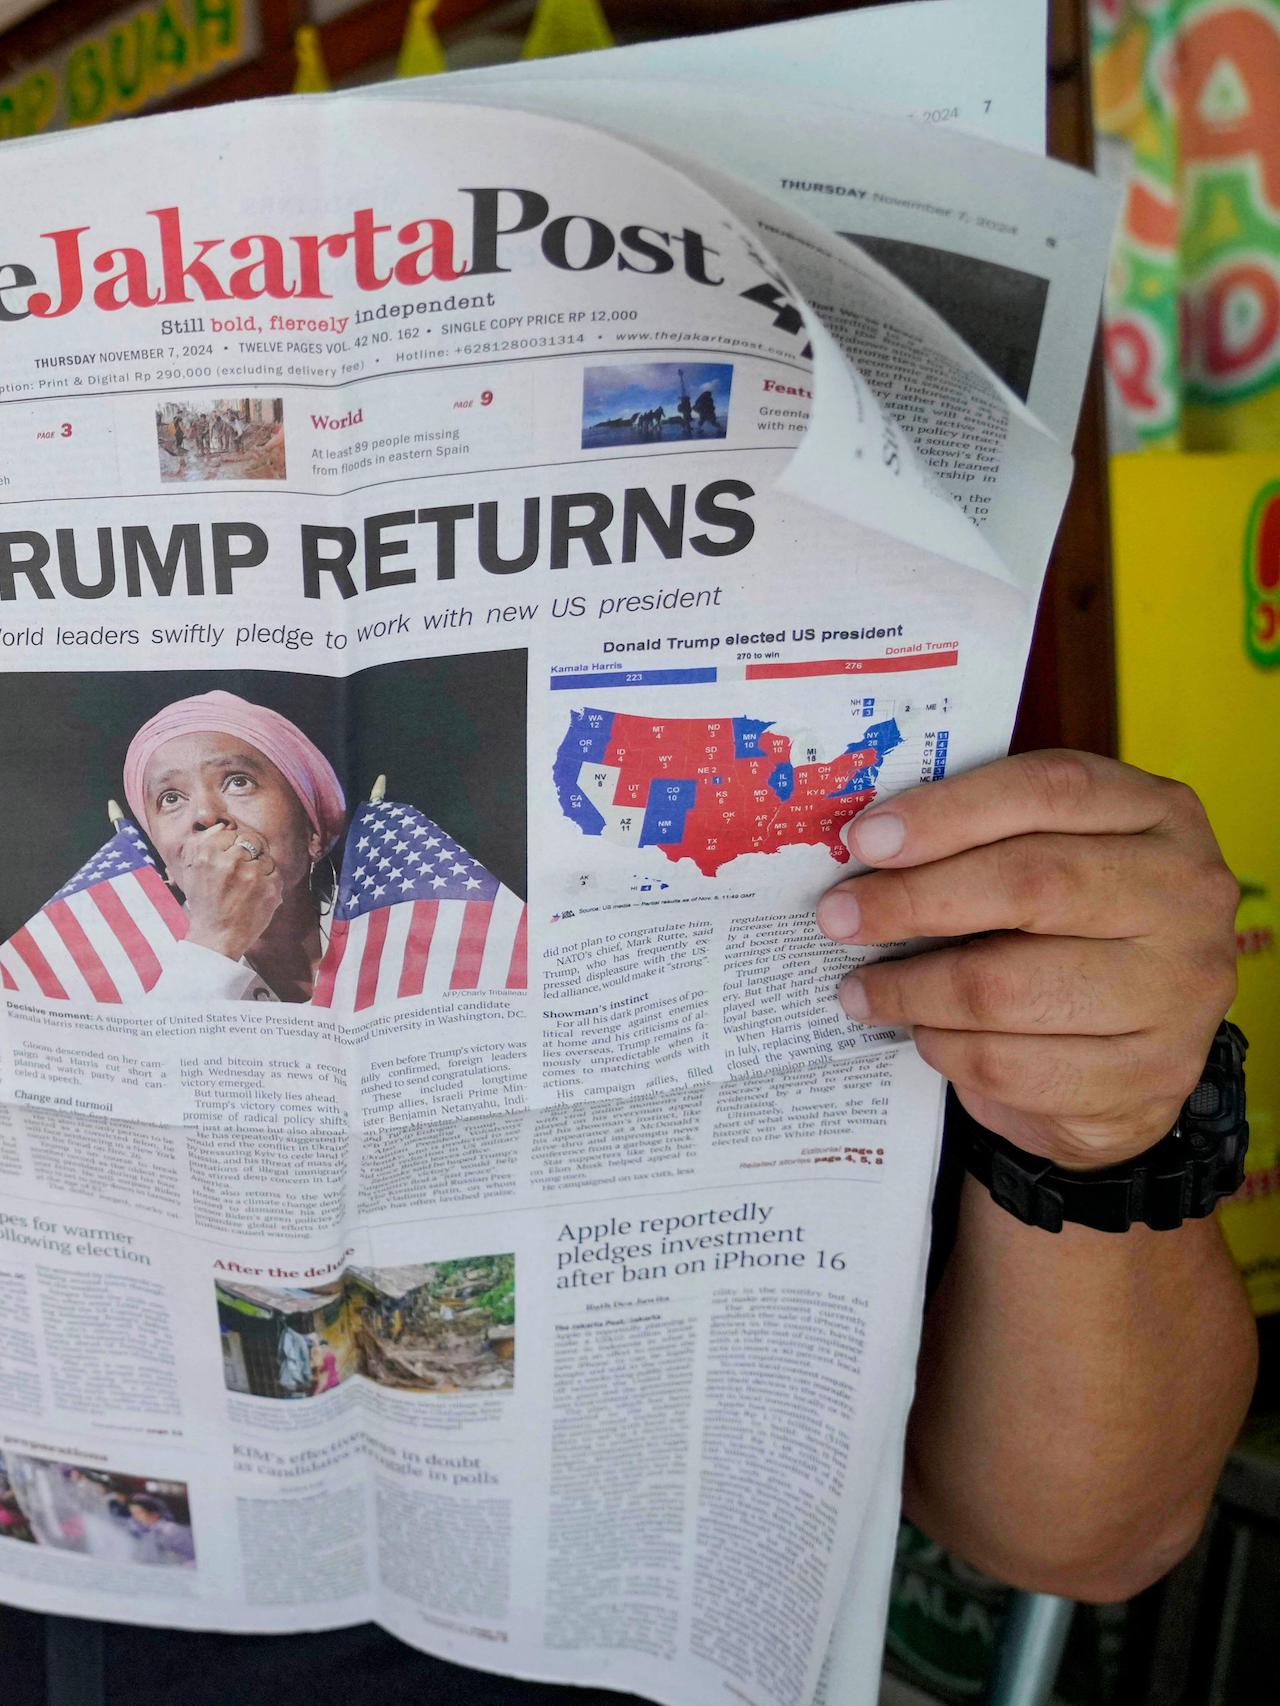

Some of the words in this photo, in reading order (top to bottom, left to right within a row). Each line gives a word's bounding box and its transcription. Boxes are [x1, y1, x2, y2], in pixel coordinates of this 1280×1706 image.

[923, 106, 959, 123] 2024
[983, 100, 992, 113] 7
[780, 179, 867, 199] THURSDAY
[874, 191, 951, 217] November
[976, 214, 1019, 236] 2024
[160, 317, 204, 335] Still
[210, 315, 262, 333] bold,
[269, 314, 349, 334] fiercely
[354, 292, 494, 324] independent
[33, 352, 96, 369] THURSDAY
[98, 347, 164, 362] NOVEMBER
[168, 346, 178, 358] 7,
[182, 343, 213, 356] 2024
[238, 341, 282, 352] TWELVE
[286, 341, 322, 354] PAGES
[325, 341, 350, 354] VOL.
[354, 335, 368, 348] 42
[371, 331, 391, 343] NO.
[398, 327, 419, 340] 162
[440, 320, 486, 335] SINGLE
[490, 316, 523, 329] COPY
[526, 312, 564, 326] PRICE
[568, 311, 586, 322] RP
[590, 310, 638, 321] 12,000
[396, 349, 448, 362] Hotline:
[455, 333, 585, 355] +6281280031314
[616, 330, 797, 359] www.thejakartapost.com
[38, 377, 68, 389] Print
[72, 376, 82, 386] &
[87, 372, 129, 385] Digital
[134, 371, 150, 382] Rp
[156, 366, 211, 379] 290,000
[216, 364, 282, 376] (excluding
[286, 364, 336, 377] delivery
[340, 361, 364, 374] fee)
[453, 400, 473, 408] PAGE
[480, 390, 494, 407] 9
[36, 431, 56, 440] PAGE
[60, 422, 73, 438] 3
[310, 407, 363, 430] World
[757, 421, 784, 431] with
[310, 448, 322, 459] At
[326, 445, 352, 459] least
[354, 440, 368, 453] 89
[371, 433, 410, 451] people
[413, 428, 460, 442] missing
[312, 464, 338, 475] from
[340, 456, 372, 473] floods
[374, 454, 385, 464] in
[388, 448, 432, 462] eastern
[436, 443, 469, 457] Spain
[300, 478, 755, 599] RETURNS
[56, 625, 139, 645] leaders
[150, 623, 224, 647] swiftly
[235, 622, 313, 649] pledge
[324, 630, 347, 649] to
[356, 613, 410, 642] work
[423, 606, 472, 630] with
[486, 604, 538, 623] new
[551, 595, 586, 618] US
[598, 586, 722, 619] president
[602, 637, 660, 653] Donald
[666, 636, 720, 650] Trump
[724, 630, 785, 645] elected
[792, 628, 815, 641] US
[820, 623, 902, 642] president
[885, 644, 923, 656] Donald
[926, 640, 959, 654] Trump
[550, 663, 588, 673] Kamala
[591, 660, 623, 670] Harris
[736, 652, 752, 660] 270
[845, 661, 863, 670] 276
[626, 673, 643, 682] 223
[6, 1000, 46, 1015] Decisive
[47, 1010, 93, 1020] moment:
[105, 1016, 152, 1026] supporter
[156, 1016, 166, 1025] of
[168, 1013, 203, 1024] United
[205, 1013, 237, 1026] States
[239, 1013, 262, 1023] Vice
[264, 1015, 314, 1026] President
[316, 1021, 335, 1031] and
[337, 1016, 390, 1035] Democratic
[393, 1002, 454, 1023] presidential
[456, 1000, 511, 1012] candidate
[542, 1004, 607, 1018] Showman's
[610, 992, 648, 1009] instinct
[14, 1089, 50, 1104] Change
[52, 1096, 72, 1106] and
[74, 1098, 112, 1111] turmoil
[33, 1216, 58, 1233] for
[63, 1225, 134, 1245] warmer
[557, 1217, 632, 1244] Apple
[640, 1202, 773, 1235] reportedly
[76, 1241, 151, 1266] election
[557, 1240, 652, 1270] pledges
[660, 1226, 803, 1257] investment
[213, 1258, 262, 1276] After
[267, 1266, 299, 1278] the
[556, 1262, 615, 1290] after
[622, 1259, 667, 1282] ban
[675, 1258, 705, 1275] on
[715, 1250, 805, 1273] iPhone
[818, 1250, 847, 1271] 16
